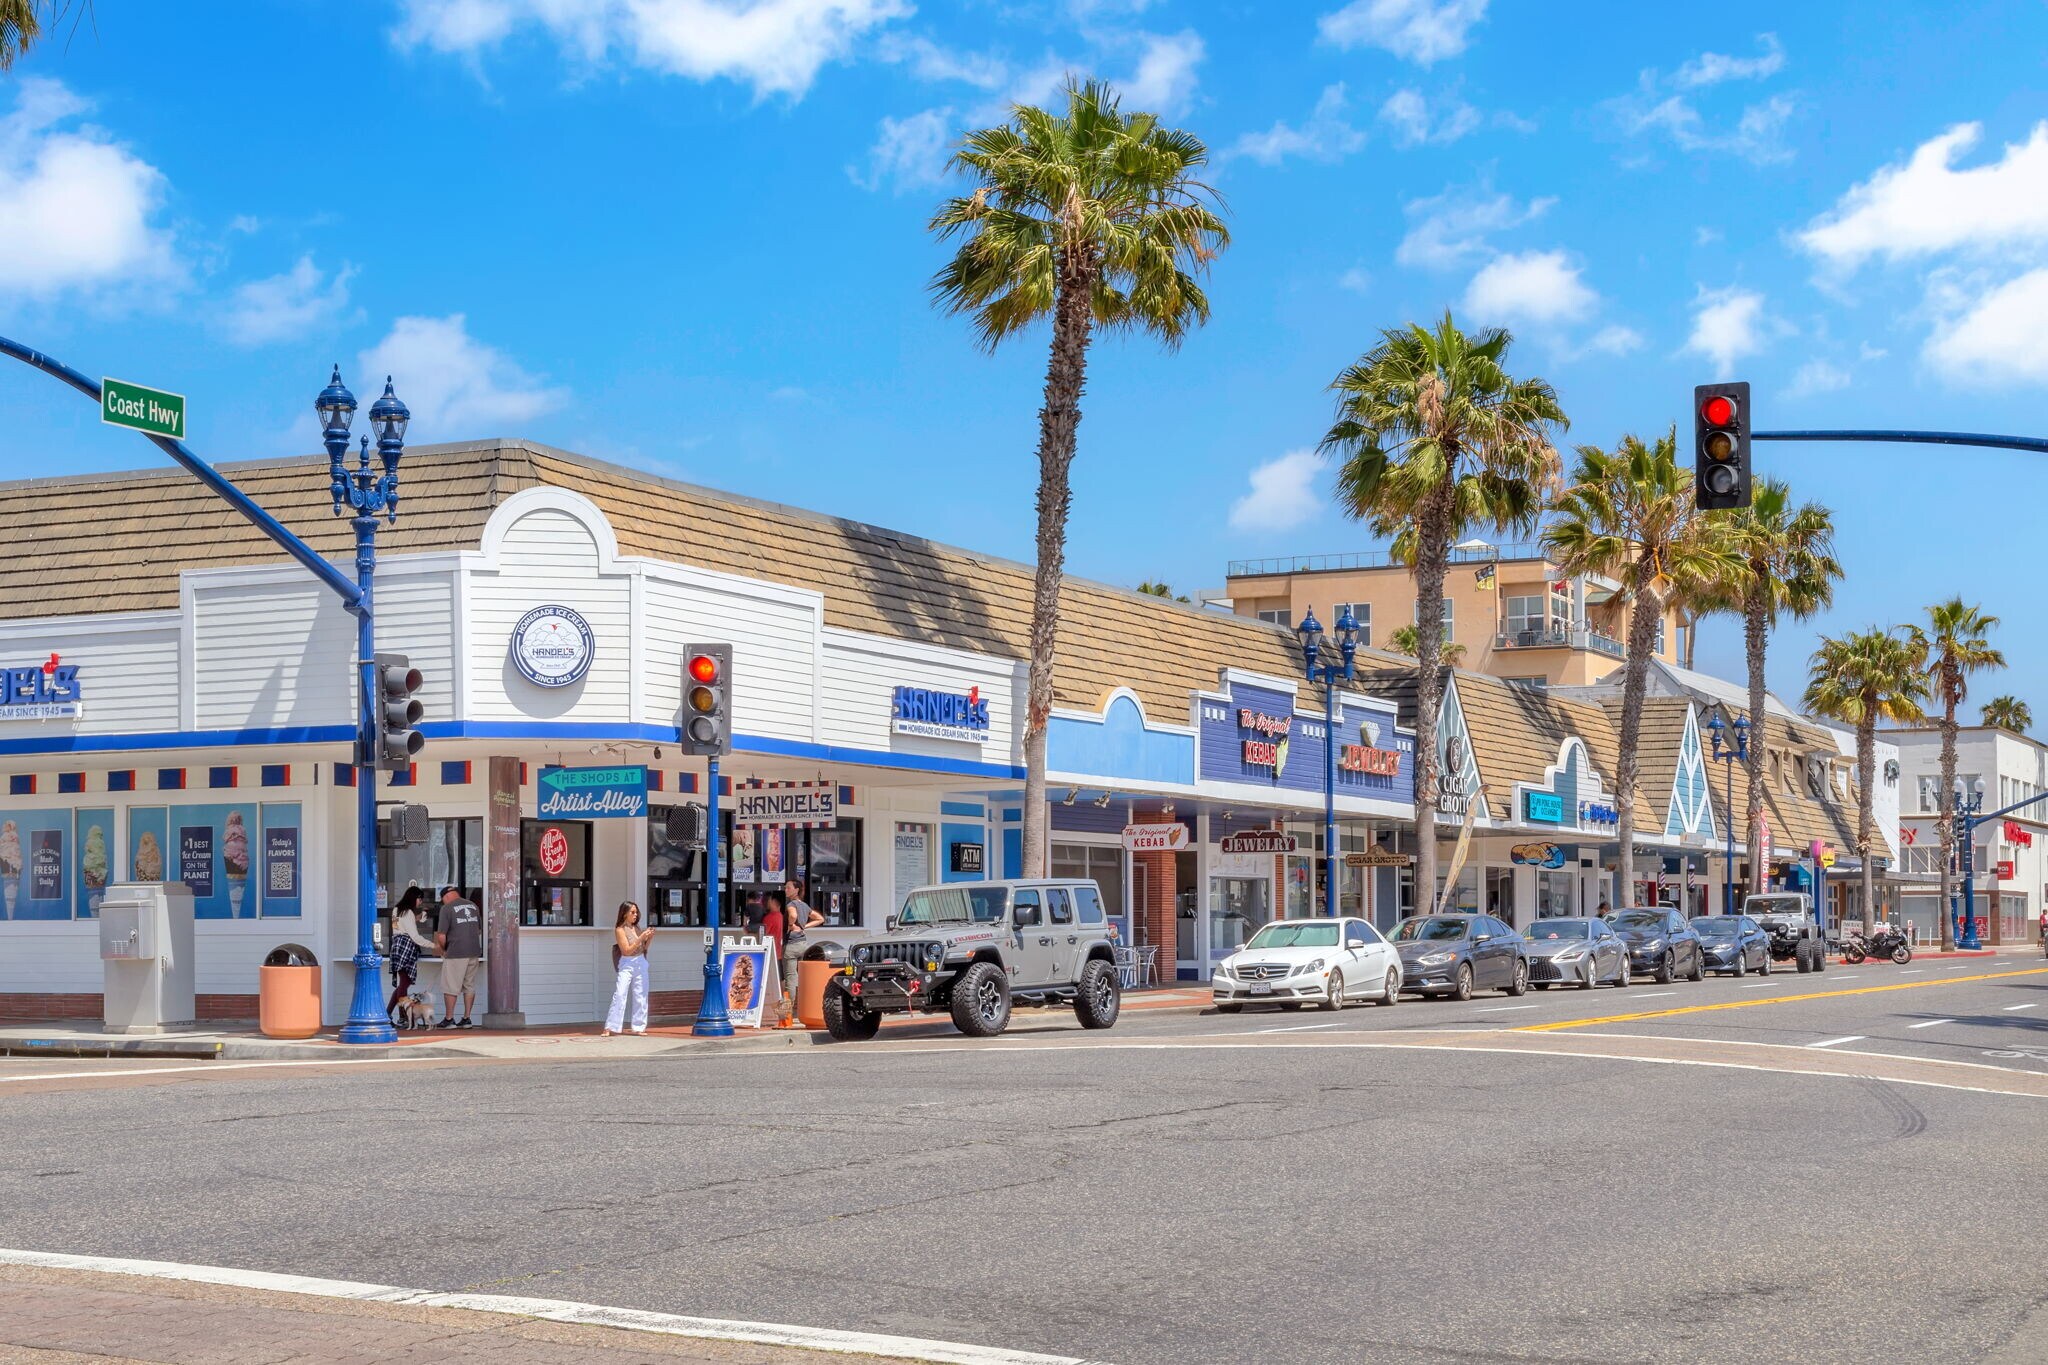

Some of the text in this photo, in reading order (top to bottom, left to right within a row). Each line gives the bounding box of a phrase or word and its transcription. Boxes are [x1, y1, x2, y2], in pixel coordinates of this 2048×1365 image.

[107, 390, 179, 432] Coast Hwy
[518, 608, 588, 635] HOMEMADE ICE CREAM
[532, 647, 575, 656] HANDEL'S
[534, 673, 572, 684] SINCE 1945
[15, 707, 38, 718] SINCE
[41, 706, 60, 716] 1945
[891, 686, 990, 730] HANDEL'S
[1241, 708, 1292, 738] The Original
[908, 724, 933, 736] HOMEMADE
[941, 728, 956, 738] CREAM
[957, 730, 970, 740] SINCE
[970, 732, 981, 742] 1945
[1245, 740, 1277, 767] KEBAB
[1343, 744, 1402, 777] JEWELRY
[555, 772, 636, 785] THE SHOPS AT
[1443, 775, 1469, 794] CIGAR
[541, 789, 643, 817] Artist Alley
[739, 792, 833, 815] HANDEL'S
[1125, 826, 1171, 837] The Original
[193, 840, 209, 849] BEST
[271, 838, 292, 848] Today's
[895, 835, 924, 849] ANDEL'S
[1134, 837, 1165, 848] KEBAB
[1224, 837, 1292, 852] JEWELRY
[182, 850, 211, 860] Ice Cream
[268, 849, 296, 857] FLAVORS
[962, 848, 980, 863] ATM
[1348, 856, 1373, 864] CIGAR
[33, 865, 60, 875] FRESH
[183, 871, 210, 879] PLANET
[954, 932, 993, 943] RUBICON
